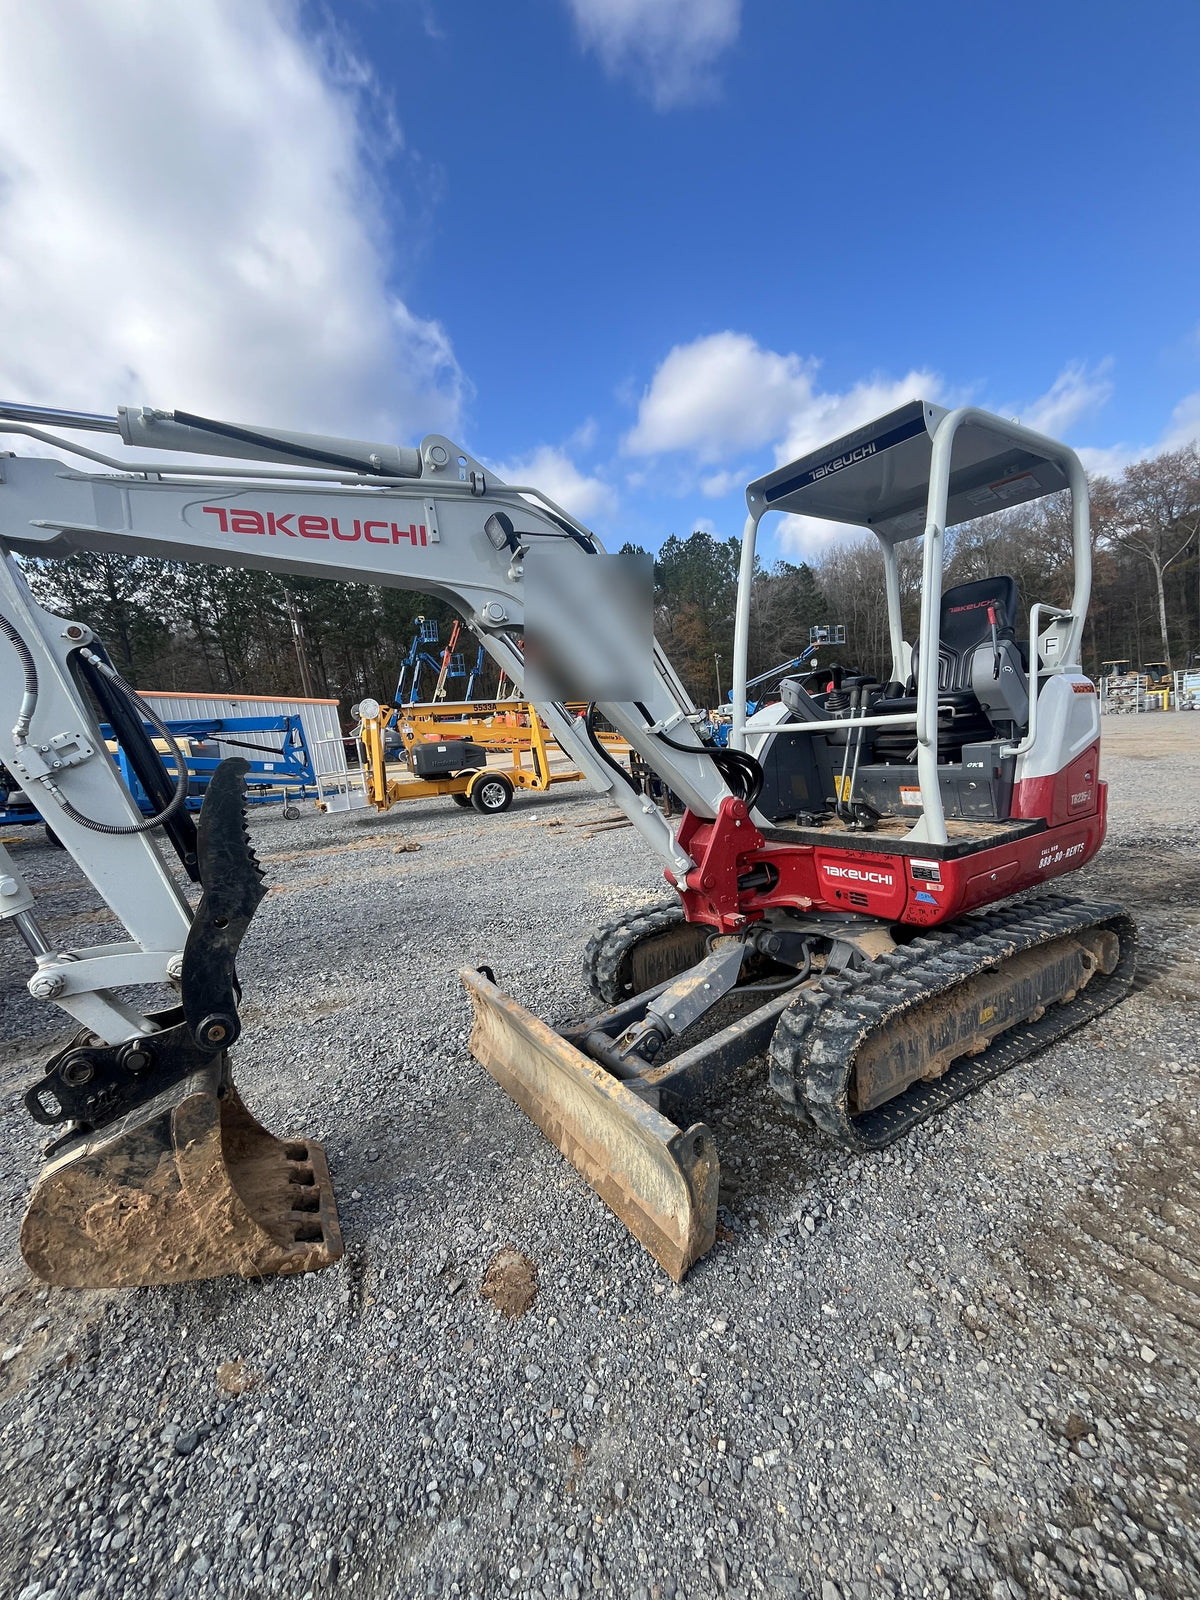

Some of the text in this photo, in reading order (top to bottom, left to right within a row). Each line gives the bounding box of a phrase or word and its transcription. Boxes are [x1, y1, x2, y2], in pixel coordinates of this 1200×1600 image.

[808, 442, 877, 480] TAKEUCHI
[202, 506, 427, 547] TAKEUCHI
[822, 865, 893, 886] TAKEUCHI
